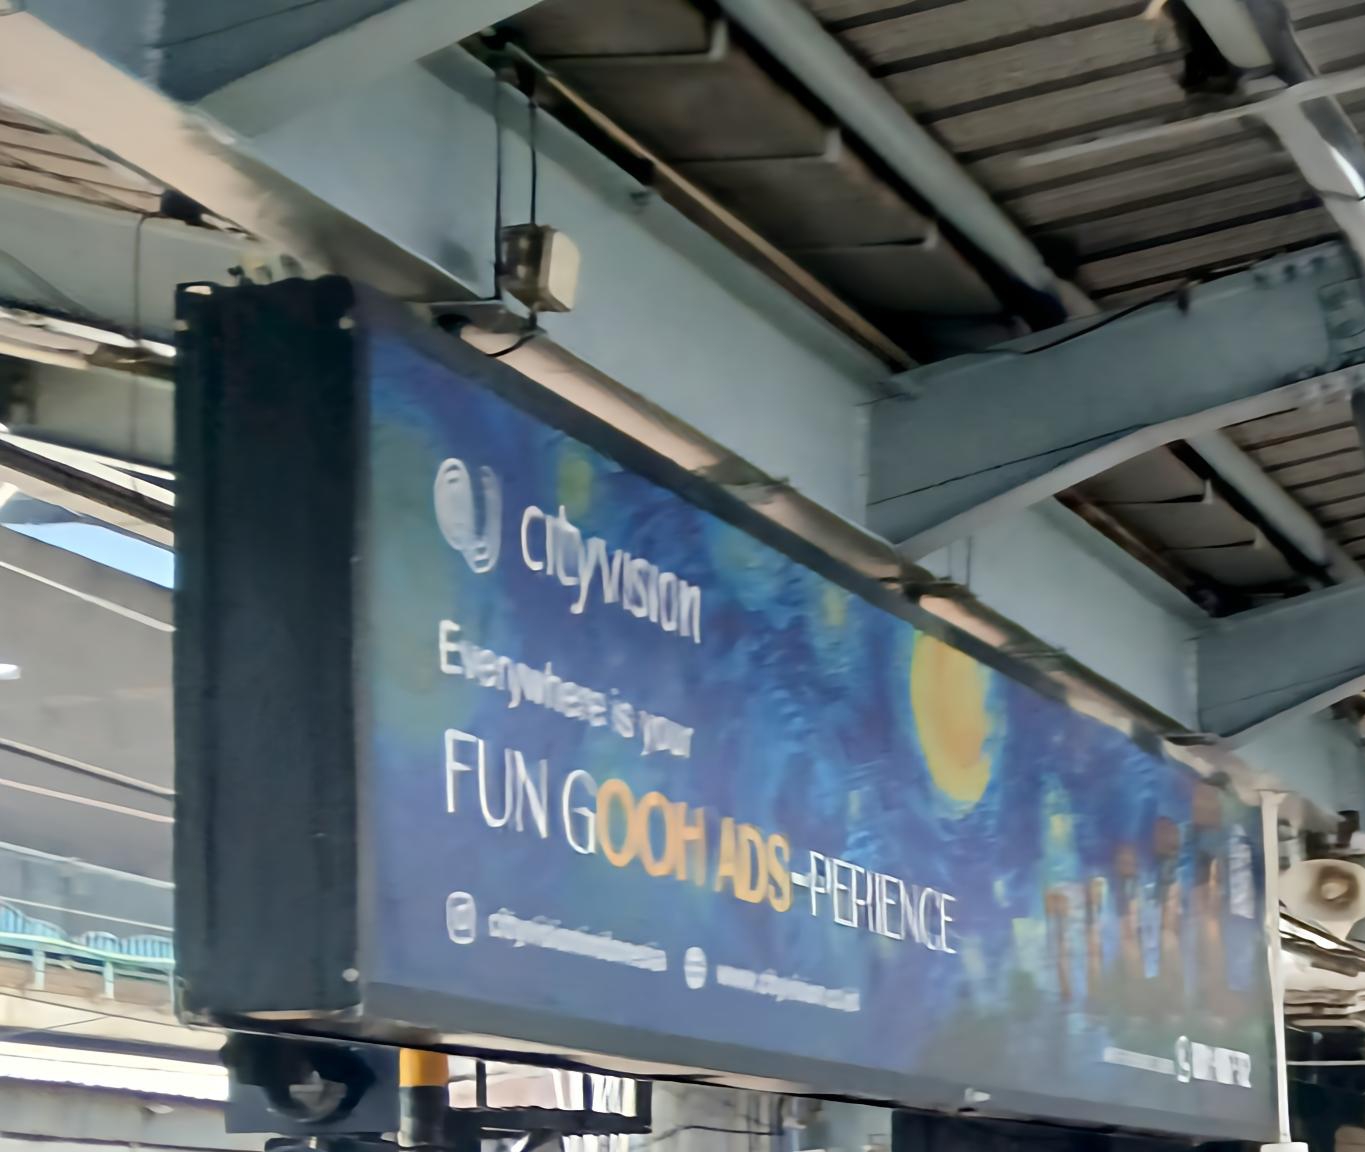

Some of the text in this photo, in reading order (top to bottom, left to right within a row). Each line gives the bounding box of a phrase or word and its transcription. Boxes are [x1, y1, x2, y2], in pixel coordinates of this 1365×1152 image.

[521, 505, 700, 643] cityvision
[439, 619, 607, 727] Everywhere
[611, 688, 634, 738] is
[445, 728, 548, 839] FUN
[562, 769, 705, 886] GOOH
